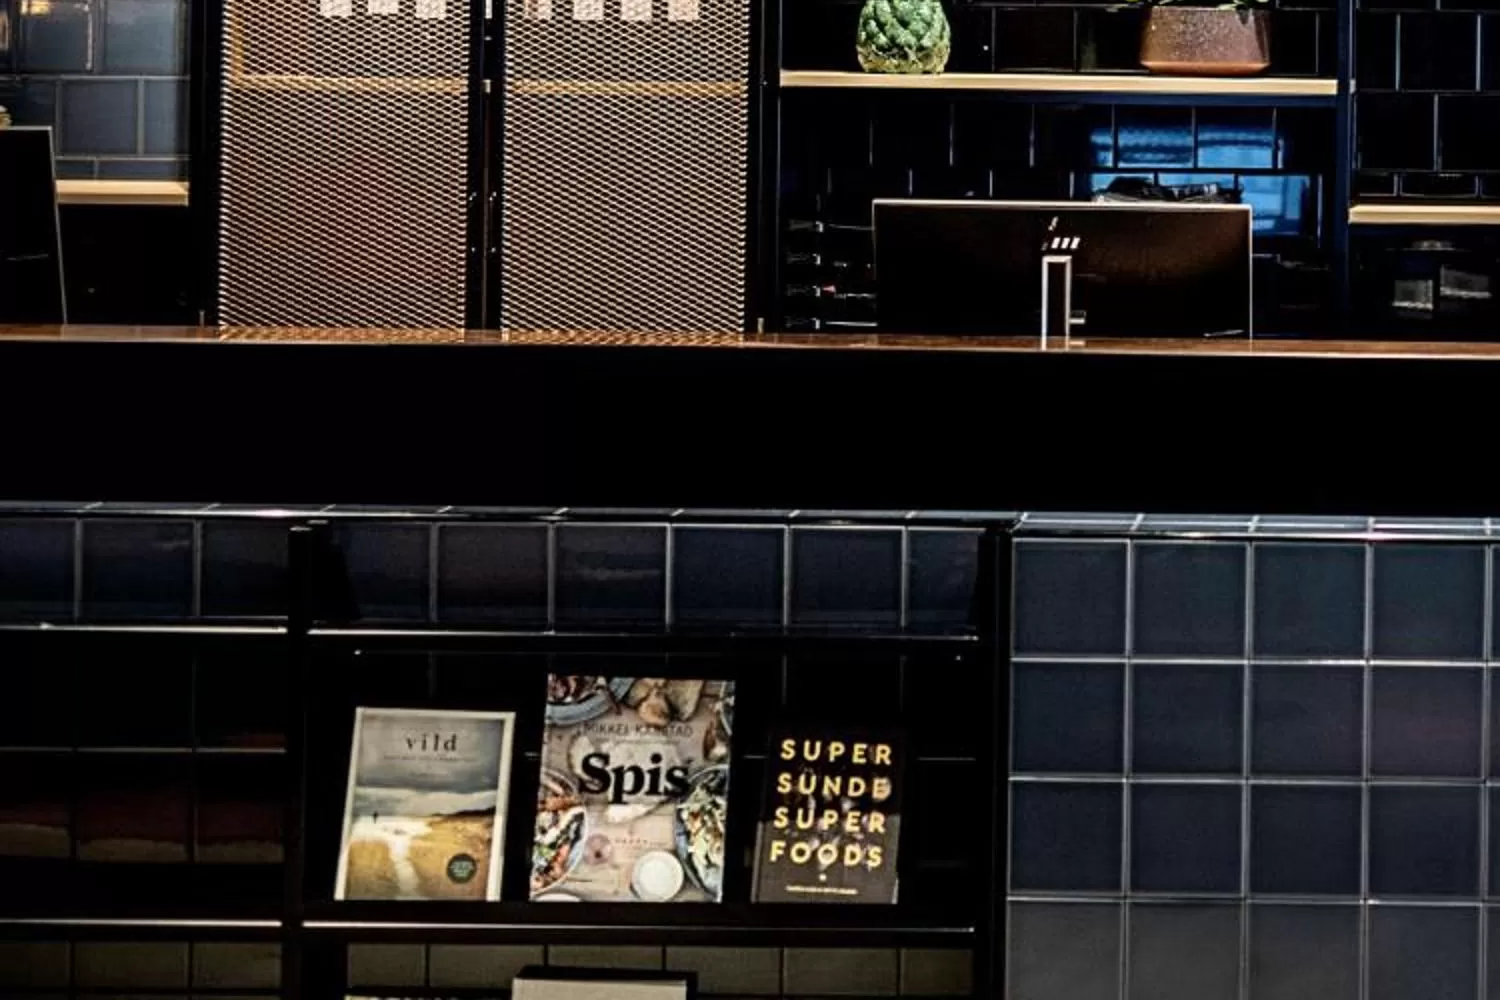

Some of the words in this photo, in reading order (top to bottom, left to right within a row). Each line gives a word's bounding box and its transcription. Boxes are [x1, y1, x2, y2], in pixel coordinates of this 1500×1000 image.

[406, 733, 457, 751] vild
[780, 738, 892, 765] SUPER
[578, 752, 692, 804] Spis
[776, 772, 892, 801] SUNDE
[773, 807, 885, 834] SUPER
[769, 840, 882, 868] FOODS
